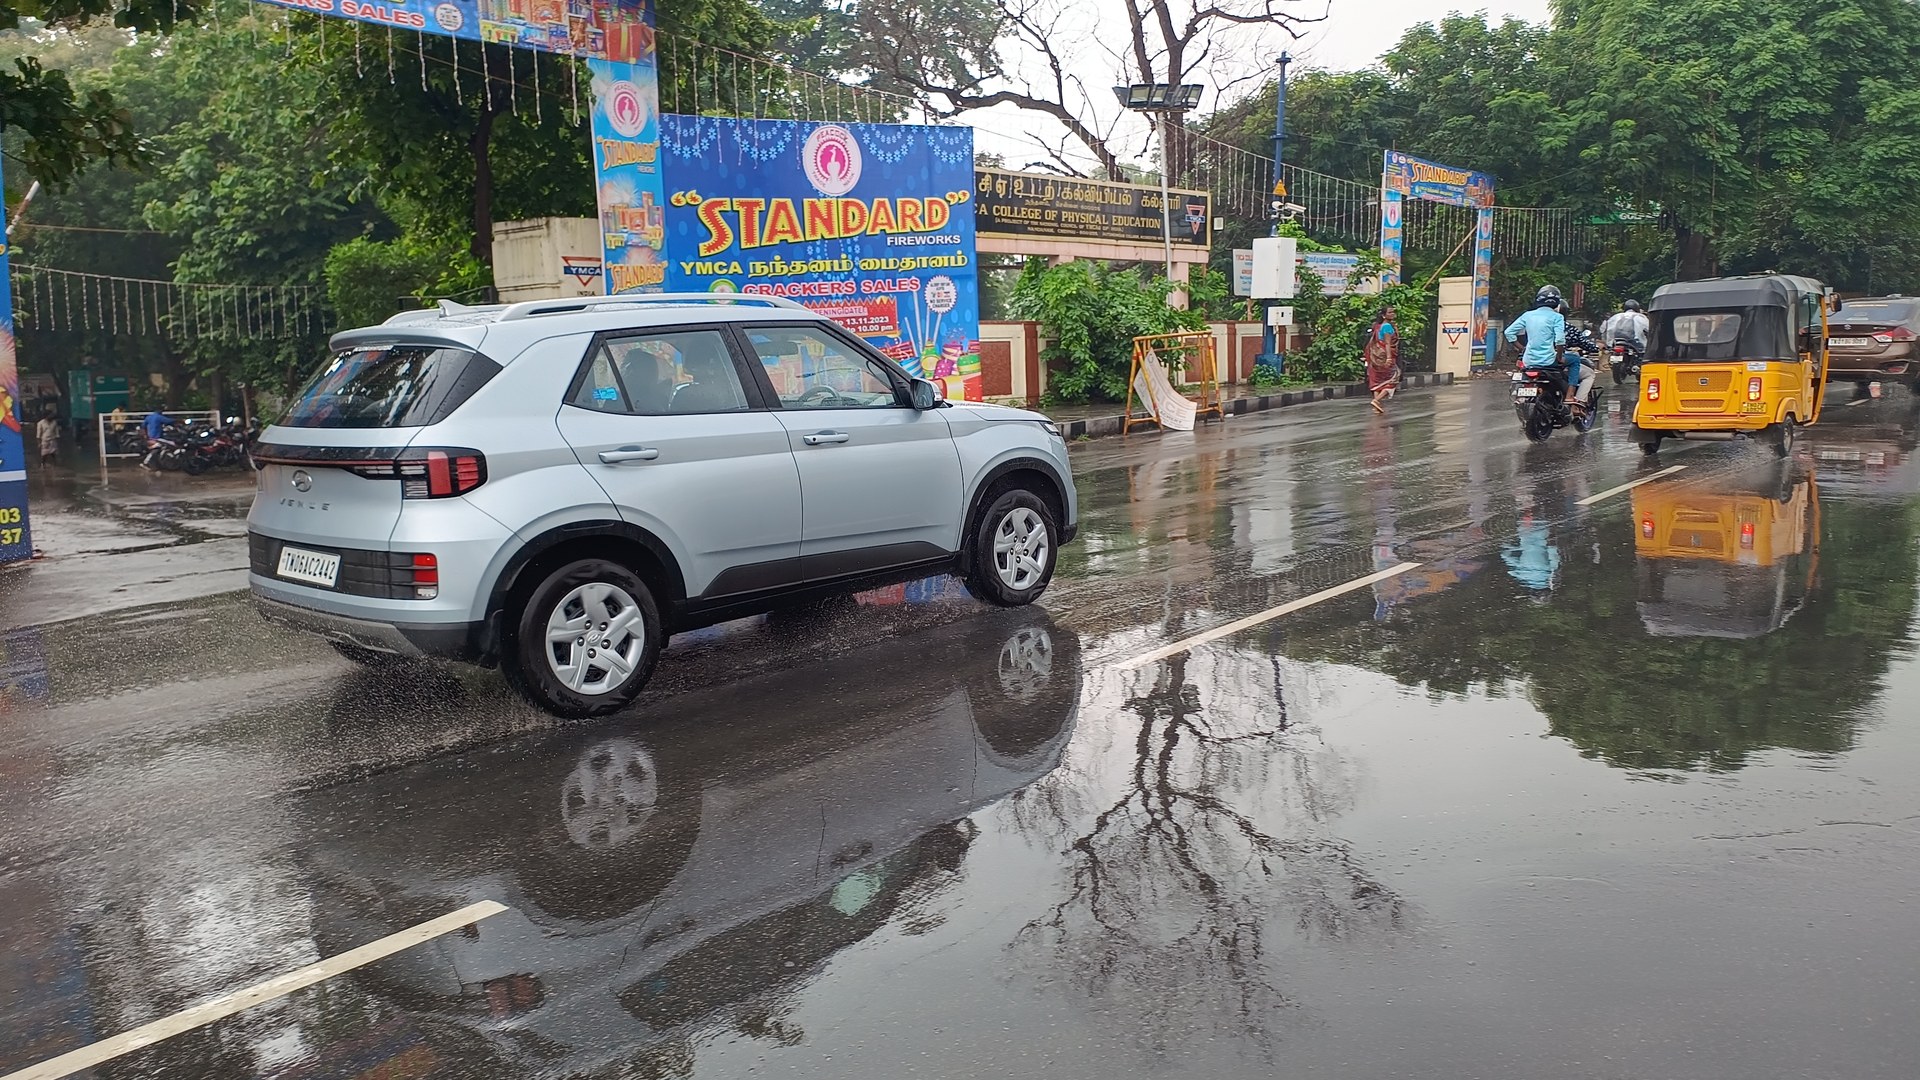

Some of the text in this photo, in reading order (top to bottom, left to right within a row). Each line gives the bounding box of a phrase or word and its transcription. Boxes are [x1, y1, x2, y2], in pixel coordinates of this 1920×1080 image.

[342, 1, 425, 28] SALES
[816, 129, 849, 143] PEACOCK
[993, 205, 1042, 219] COLLEGE
[1045, 209, 1058, 220] OF
[1062, 211, 1109, 225] PHYSICAL
[1112, 215, 1160, 229] EDUCATION
[886, 235, 961, 247] FIREWORKS
[570, 267, 602, 275] YMCA
[680, 250, 968, 278] YMCA நந்தனம் மைதானம்
[742, 278, 920, 296] CRACKERS SALES
[846, 316, 890, 325] 13.11.2023
[881, 324, 894, 332] pm
[0, 507, 21, 525] 03
[0, 527, 22, 545] 37
